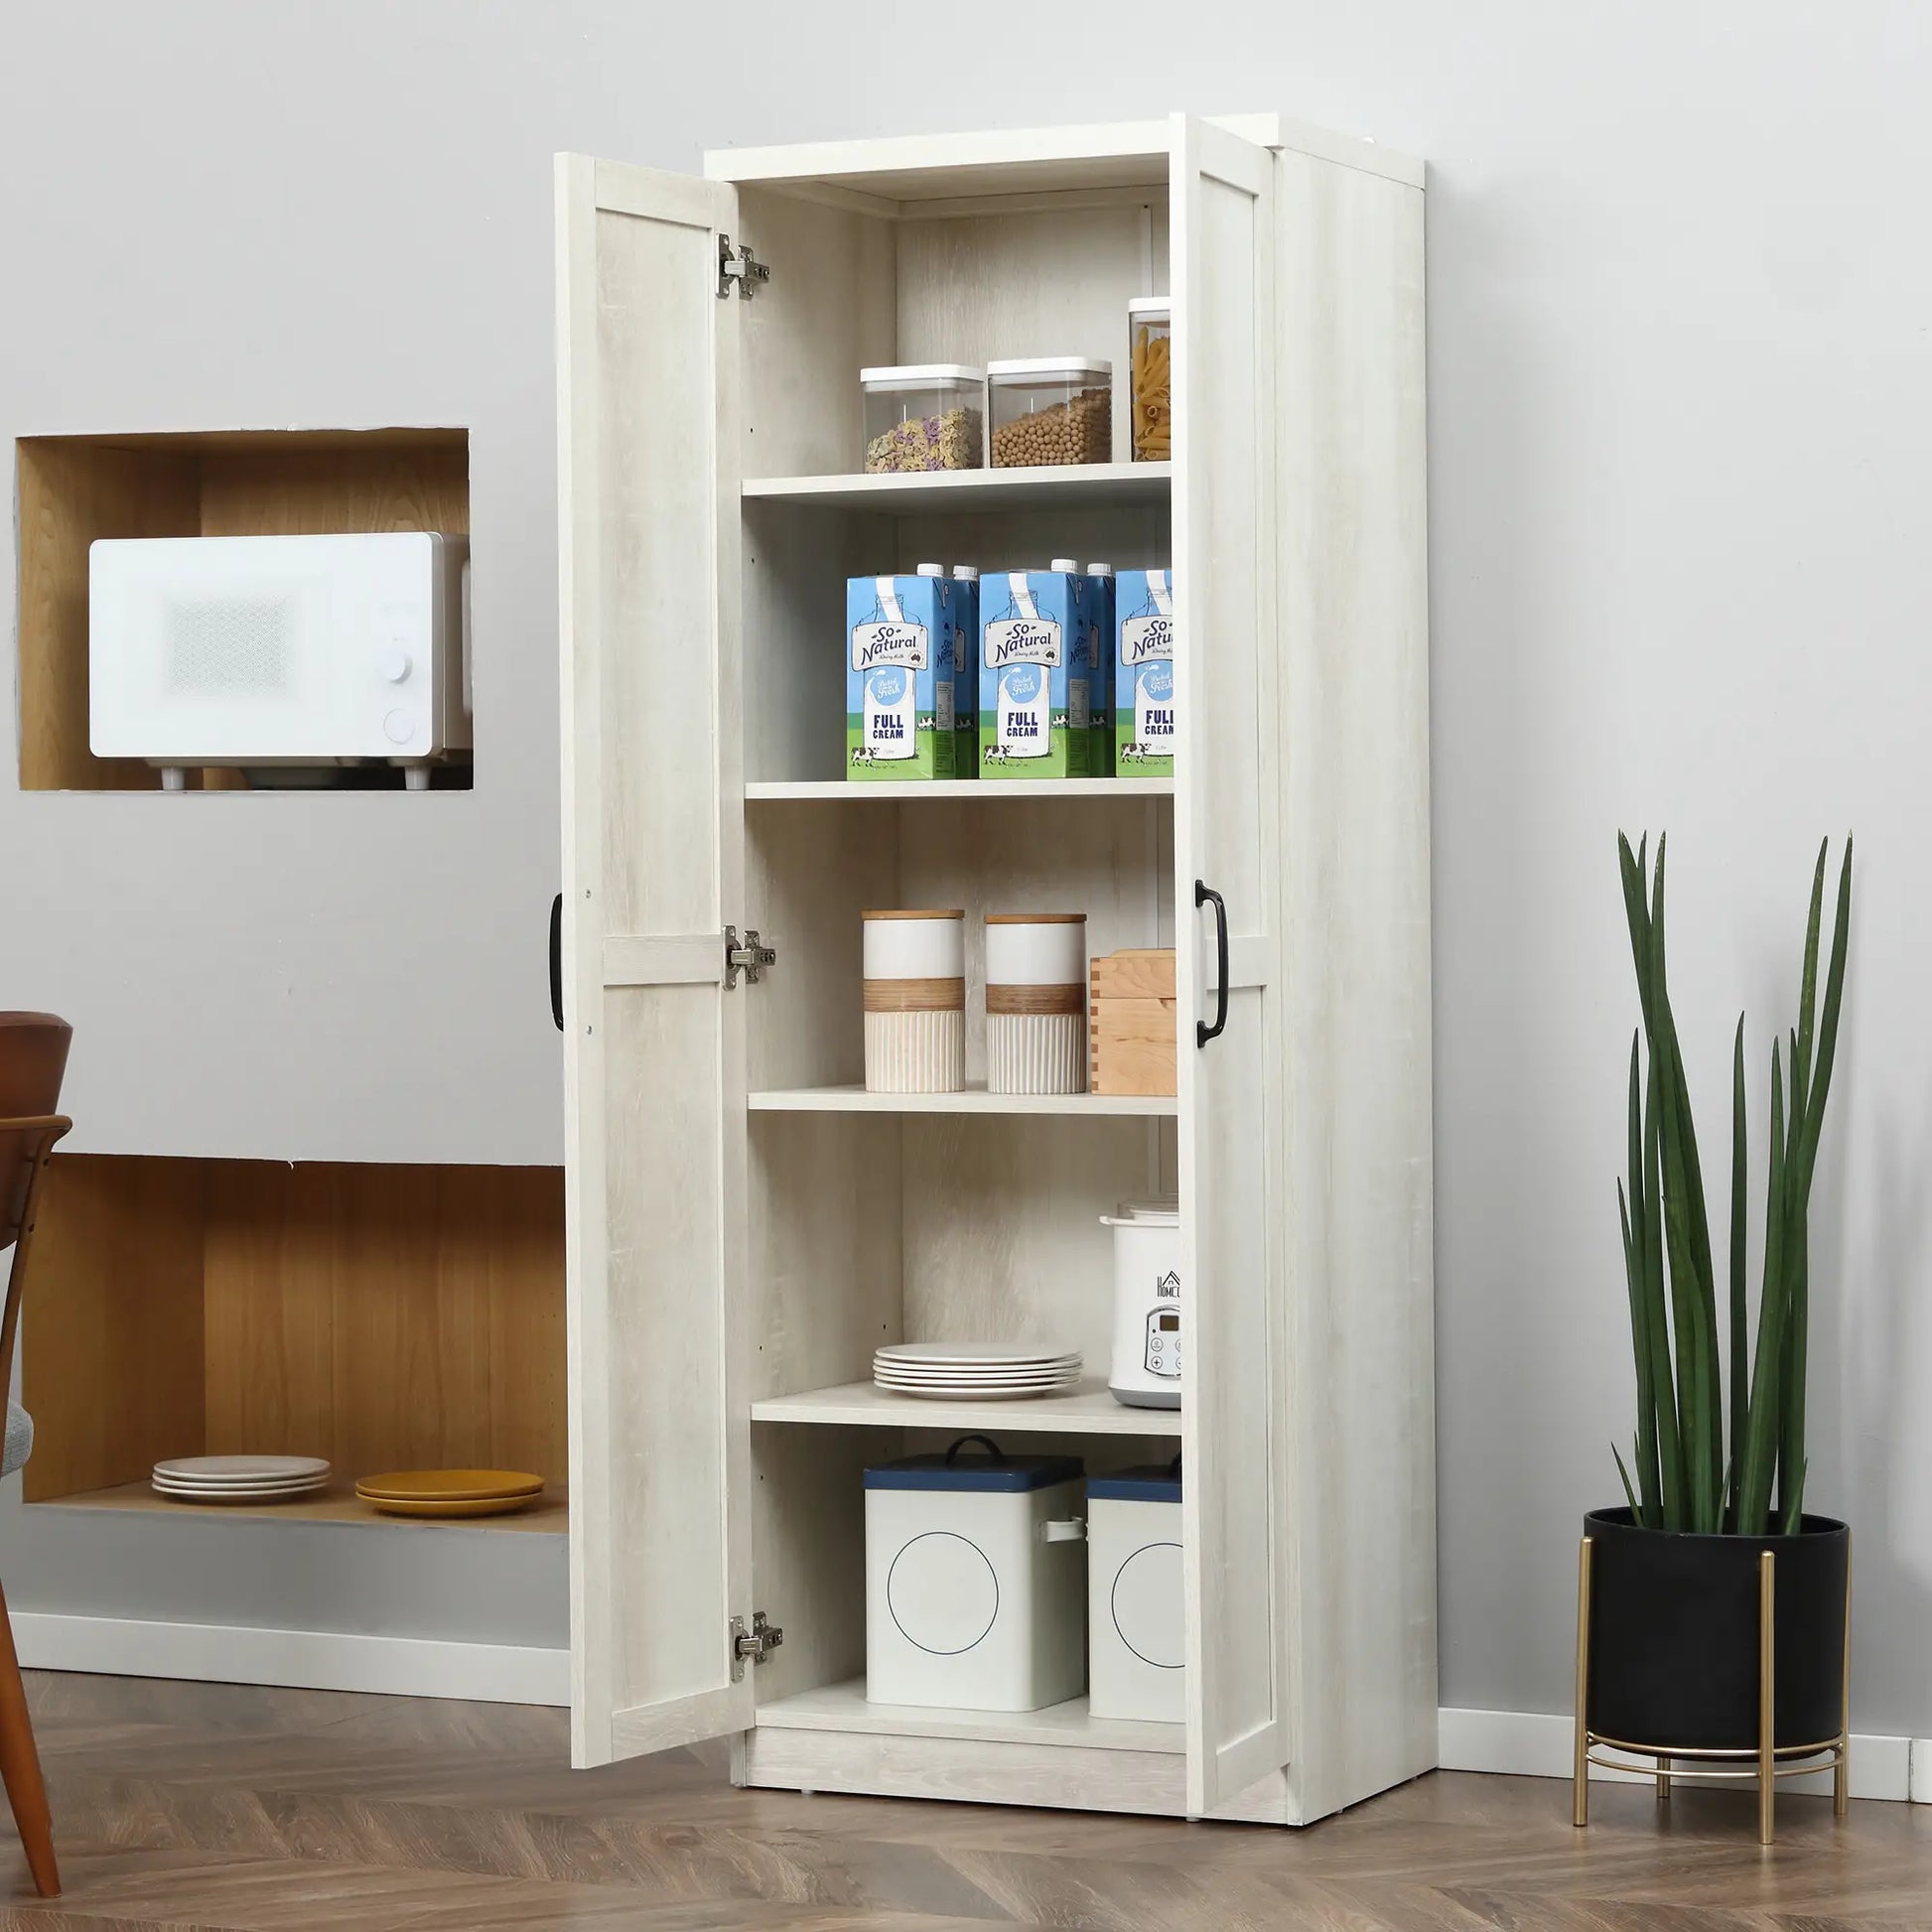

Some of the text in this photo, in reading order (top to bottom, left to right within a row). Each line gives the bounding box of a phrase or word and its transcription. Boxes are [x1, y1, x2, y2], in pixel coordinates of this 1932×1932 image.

[877, 626, 895, 642] So
[1011, 623, 1030, 639] So
[1149, 621, 1168, 636] So
[861, 635, 916, 665] Natural
[995, 632, 1051, 662] Natural
[1132, 632, 1173, 659] Natu
[874, 714, 903, 729] FULL
[1008, 712, 1038, 726] FULL
[873, 729, 903, 739] CREAM
[1007, 727, 1038, 737] CREAM
